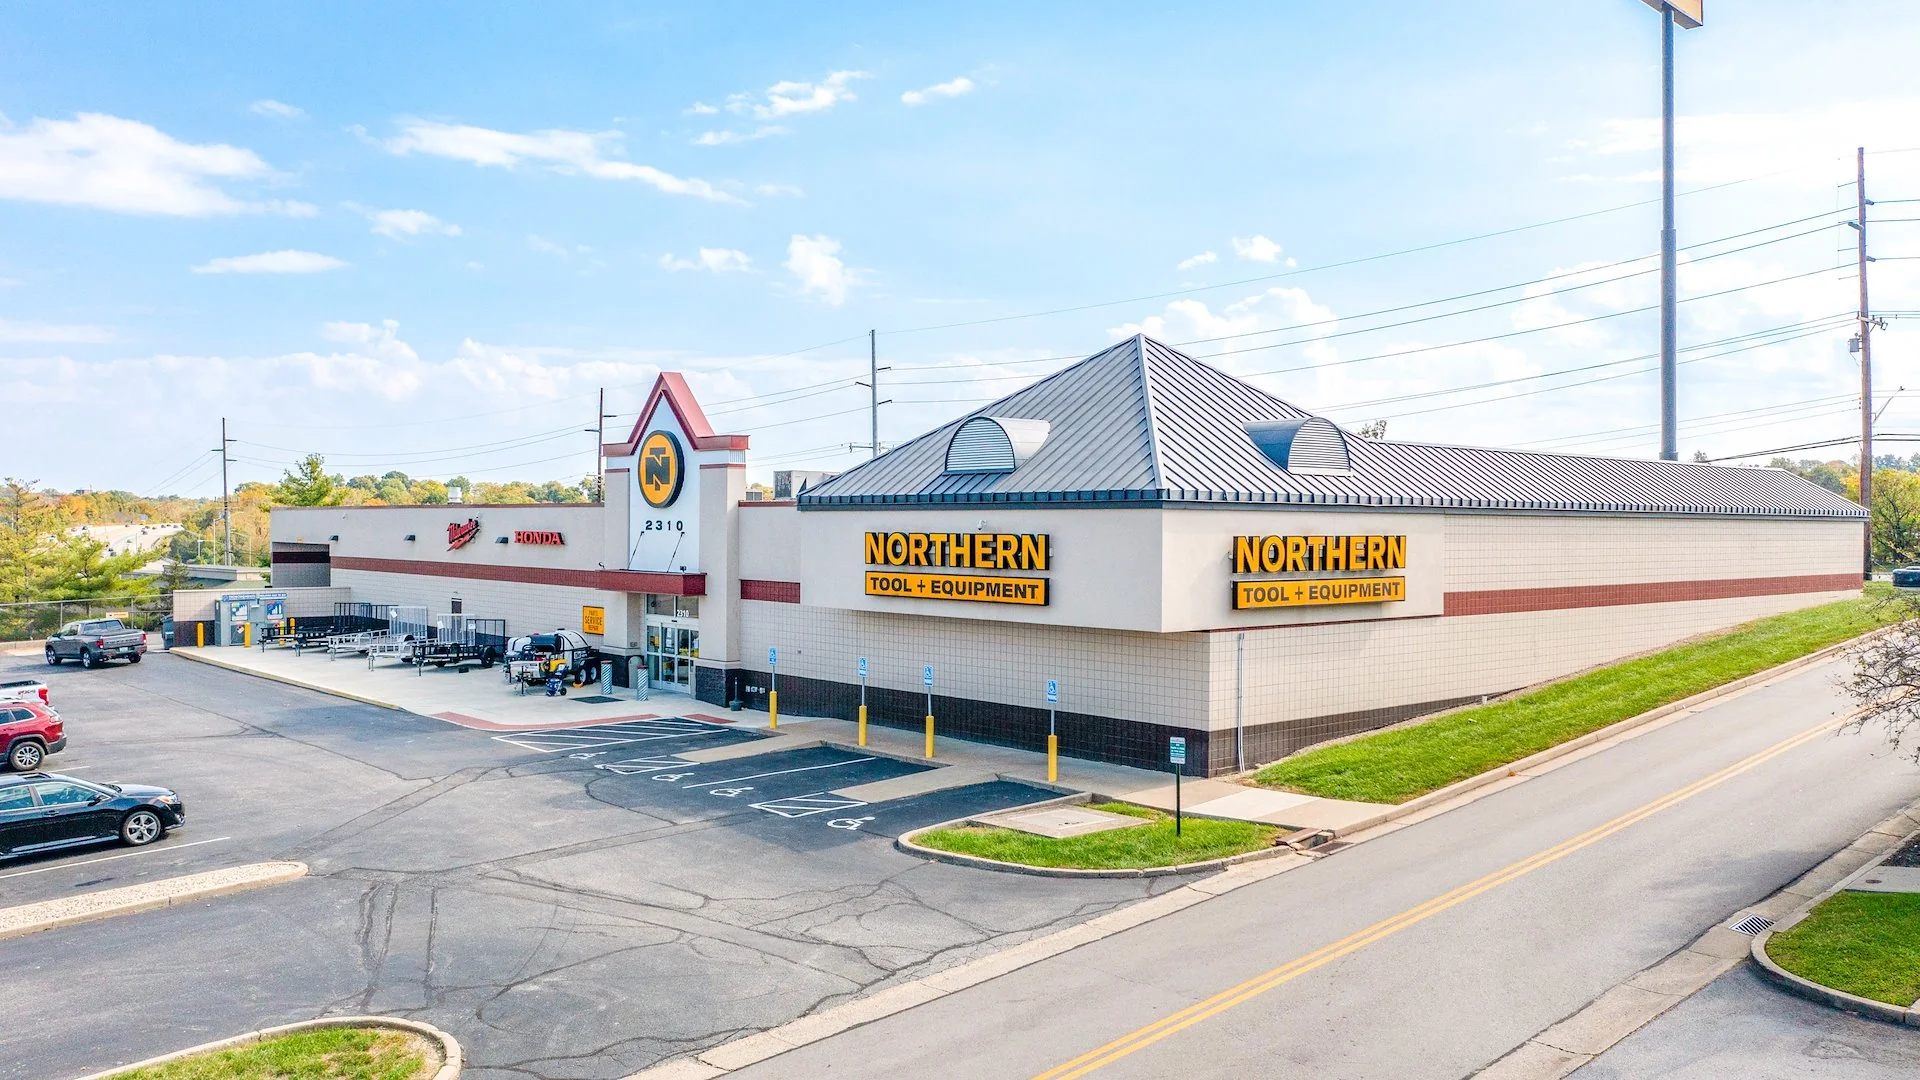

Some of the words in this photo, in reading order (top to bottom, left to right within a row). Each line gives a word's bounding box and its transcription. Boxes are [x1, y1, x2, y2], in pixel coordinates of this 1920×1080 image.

[645, 520, 683, 531] 2310
[514, 531, 562, 545] HONDA
[865, 532, 1049, 570] NORTHERN
[1233, 535, 1406, 573] NORTHERN
[870, 577, 912, 592] TOOL
[931, 580, 1039, 599] EQUIPMENT
[1243, 587, 1290, 603] TOOL
[1308, 582, 1401, 600] EQUIPMENT
[677, 609, 690, 618] 2310
